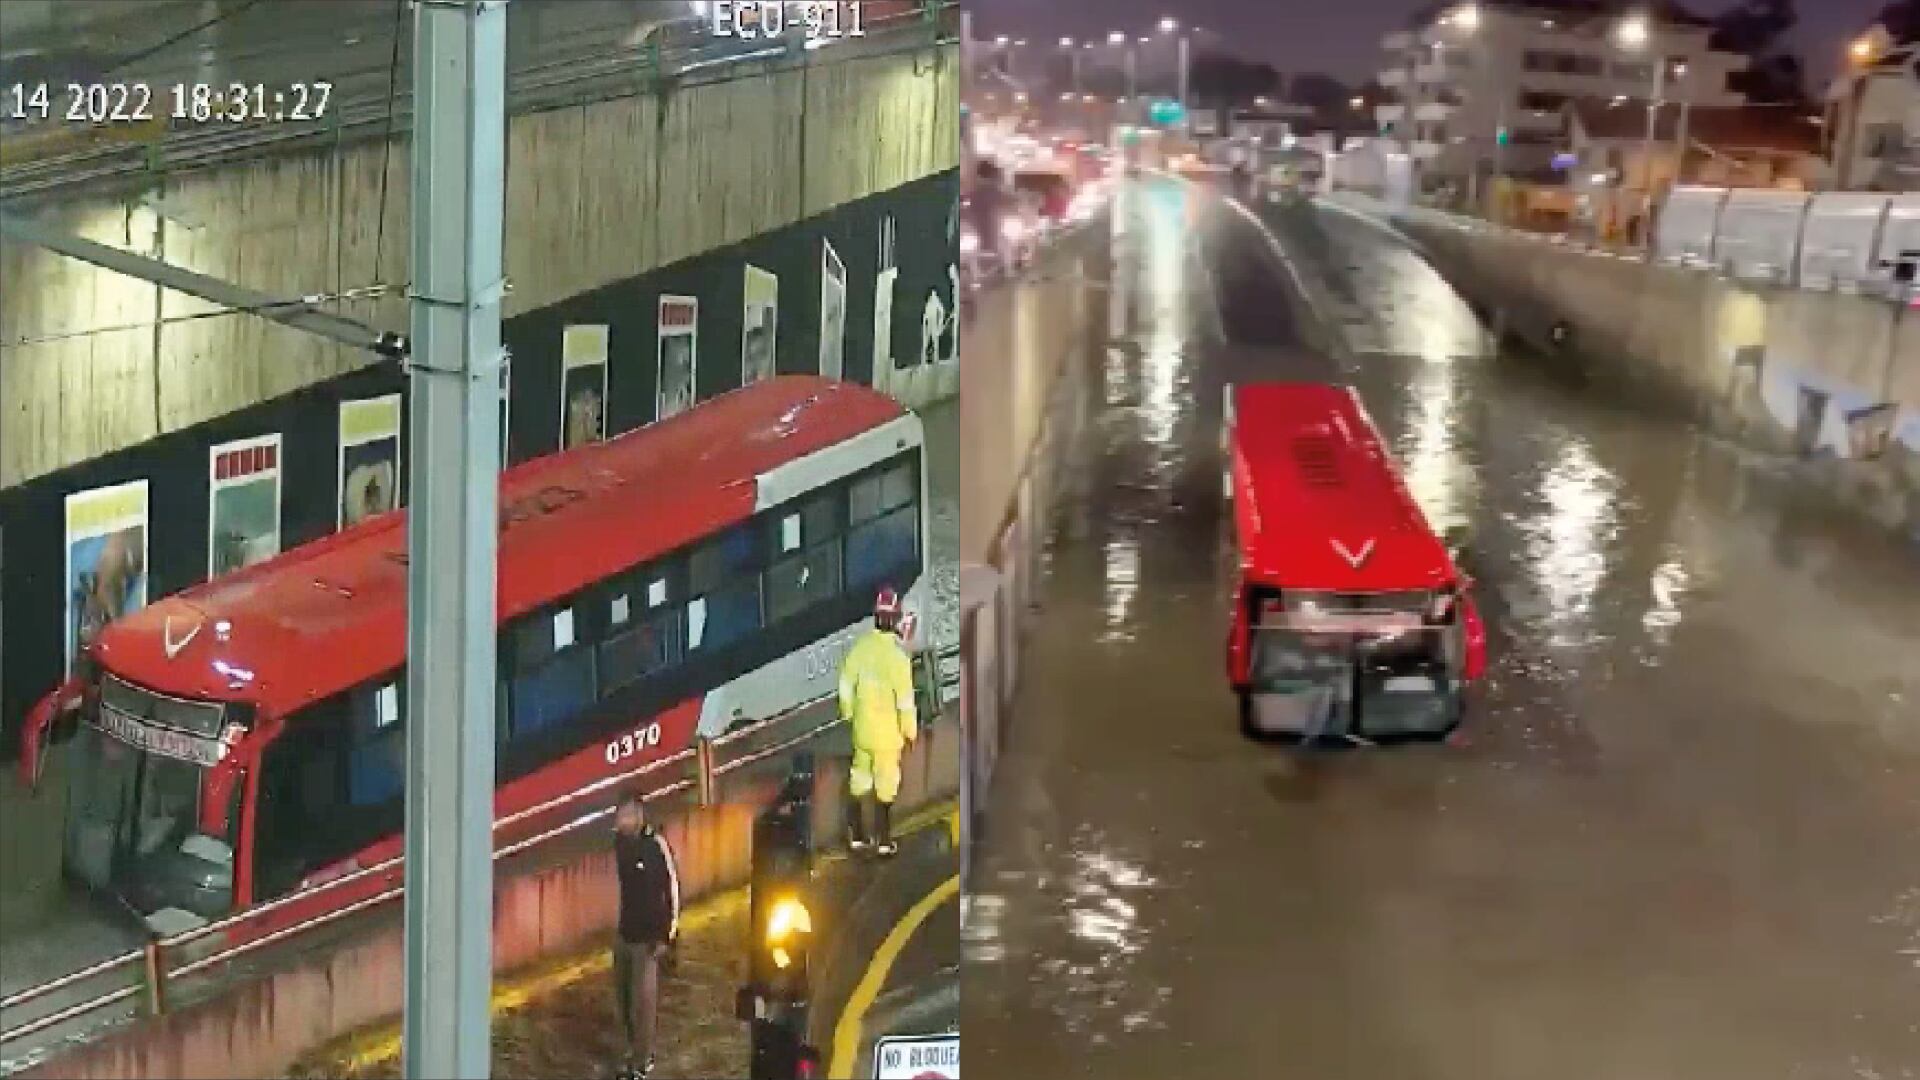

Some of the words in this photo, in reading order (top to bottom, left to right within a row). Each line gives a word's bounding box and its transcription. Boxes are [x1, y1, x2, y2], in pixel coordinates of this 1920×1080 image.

[605, 722, 661, 764] 0370
[885, 1049, 901, 1068] NO
[910, 1046, 960, 1067] BLOQUE
